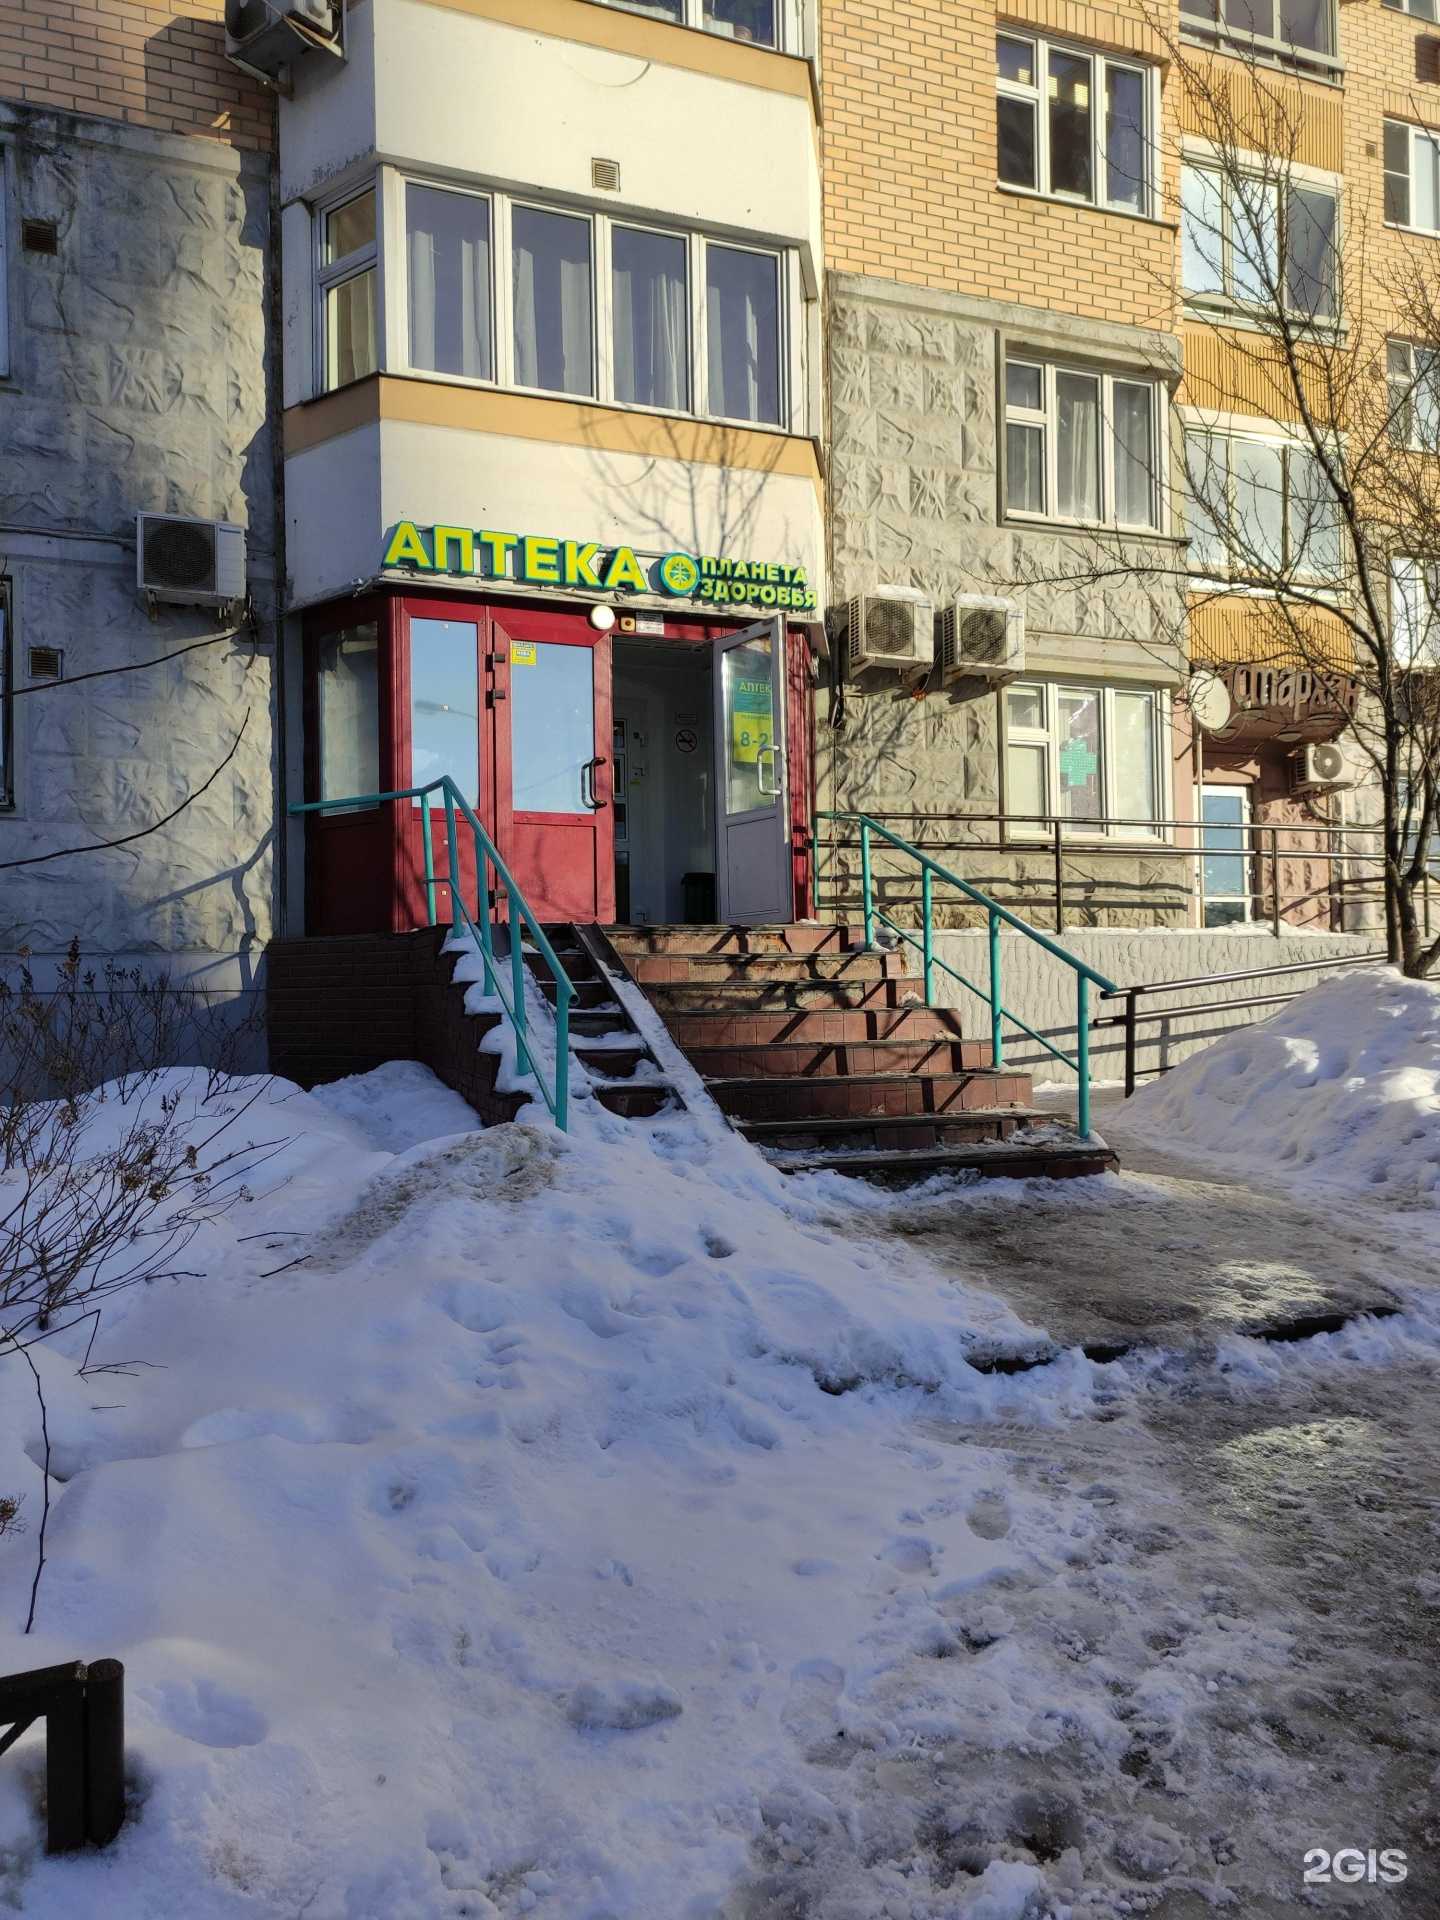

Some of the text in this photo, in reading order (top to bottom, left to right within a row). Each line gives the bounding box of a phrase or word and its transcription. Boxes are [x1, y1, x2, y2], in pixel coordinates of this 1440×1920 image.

[383, 520, 649, 592] АПТЕКА
[701, 556, 808, 585] ПЛАНЕТА
[700, 577, 817, 609] ЗДОРОВЬЯ
